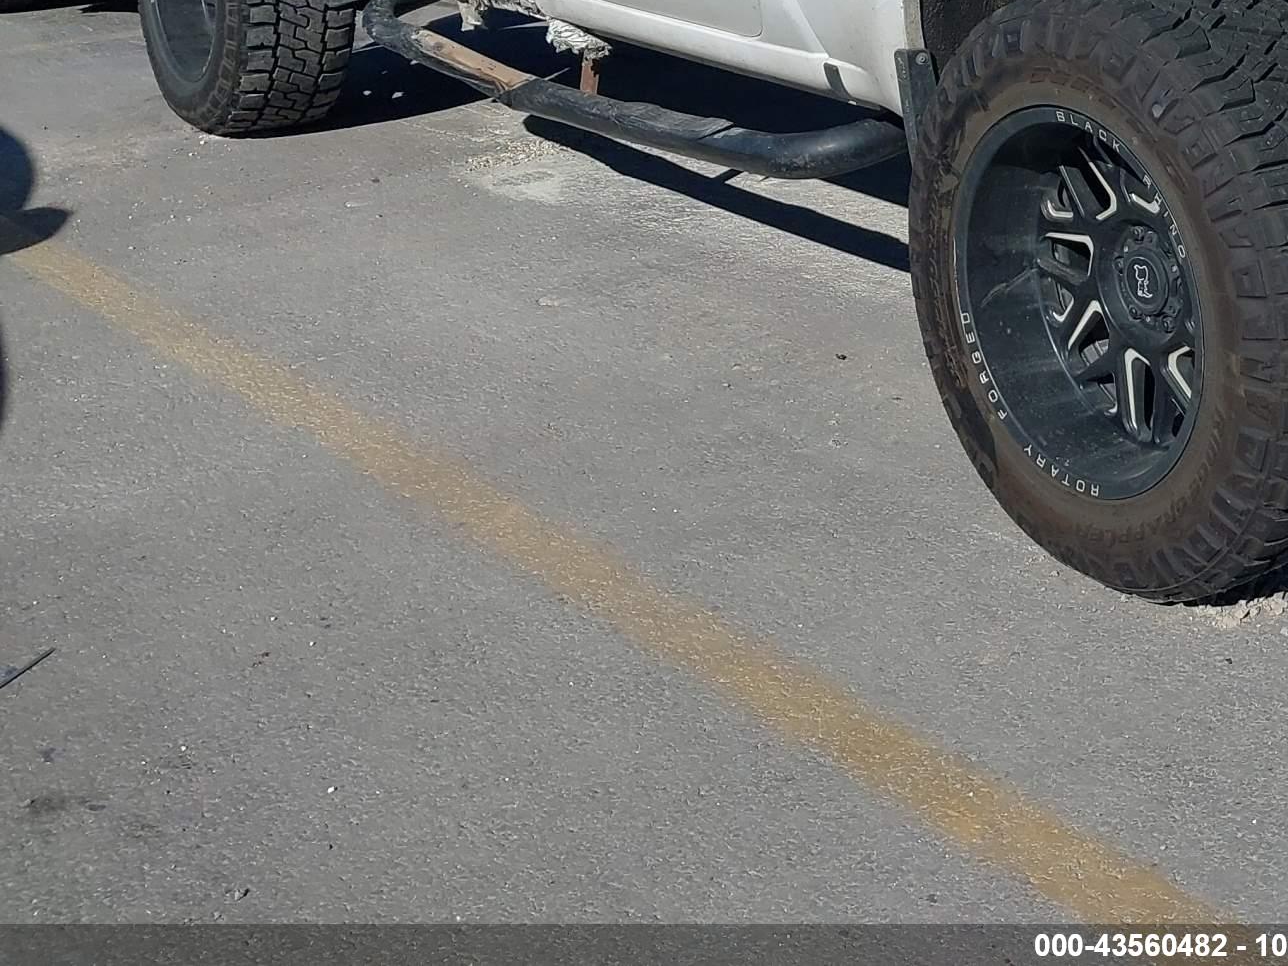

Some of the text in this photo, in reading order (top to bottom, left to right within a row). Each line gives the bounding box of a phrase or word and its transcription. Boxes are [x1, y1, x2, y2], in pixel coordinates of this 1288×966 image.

[1055, 110, 1187, 260] BLACK RHINO
[960, 311, 1100, 497] ROTARY FORGED
